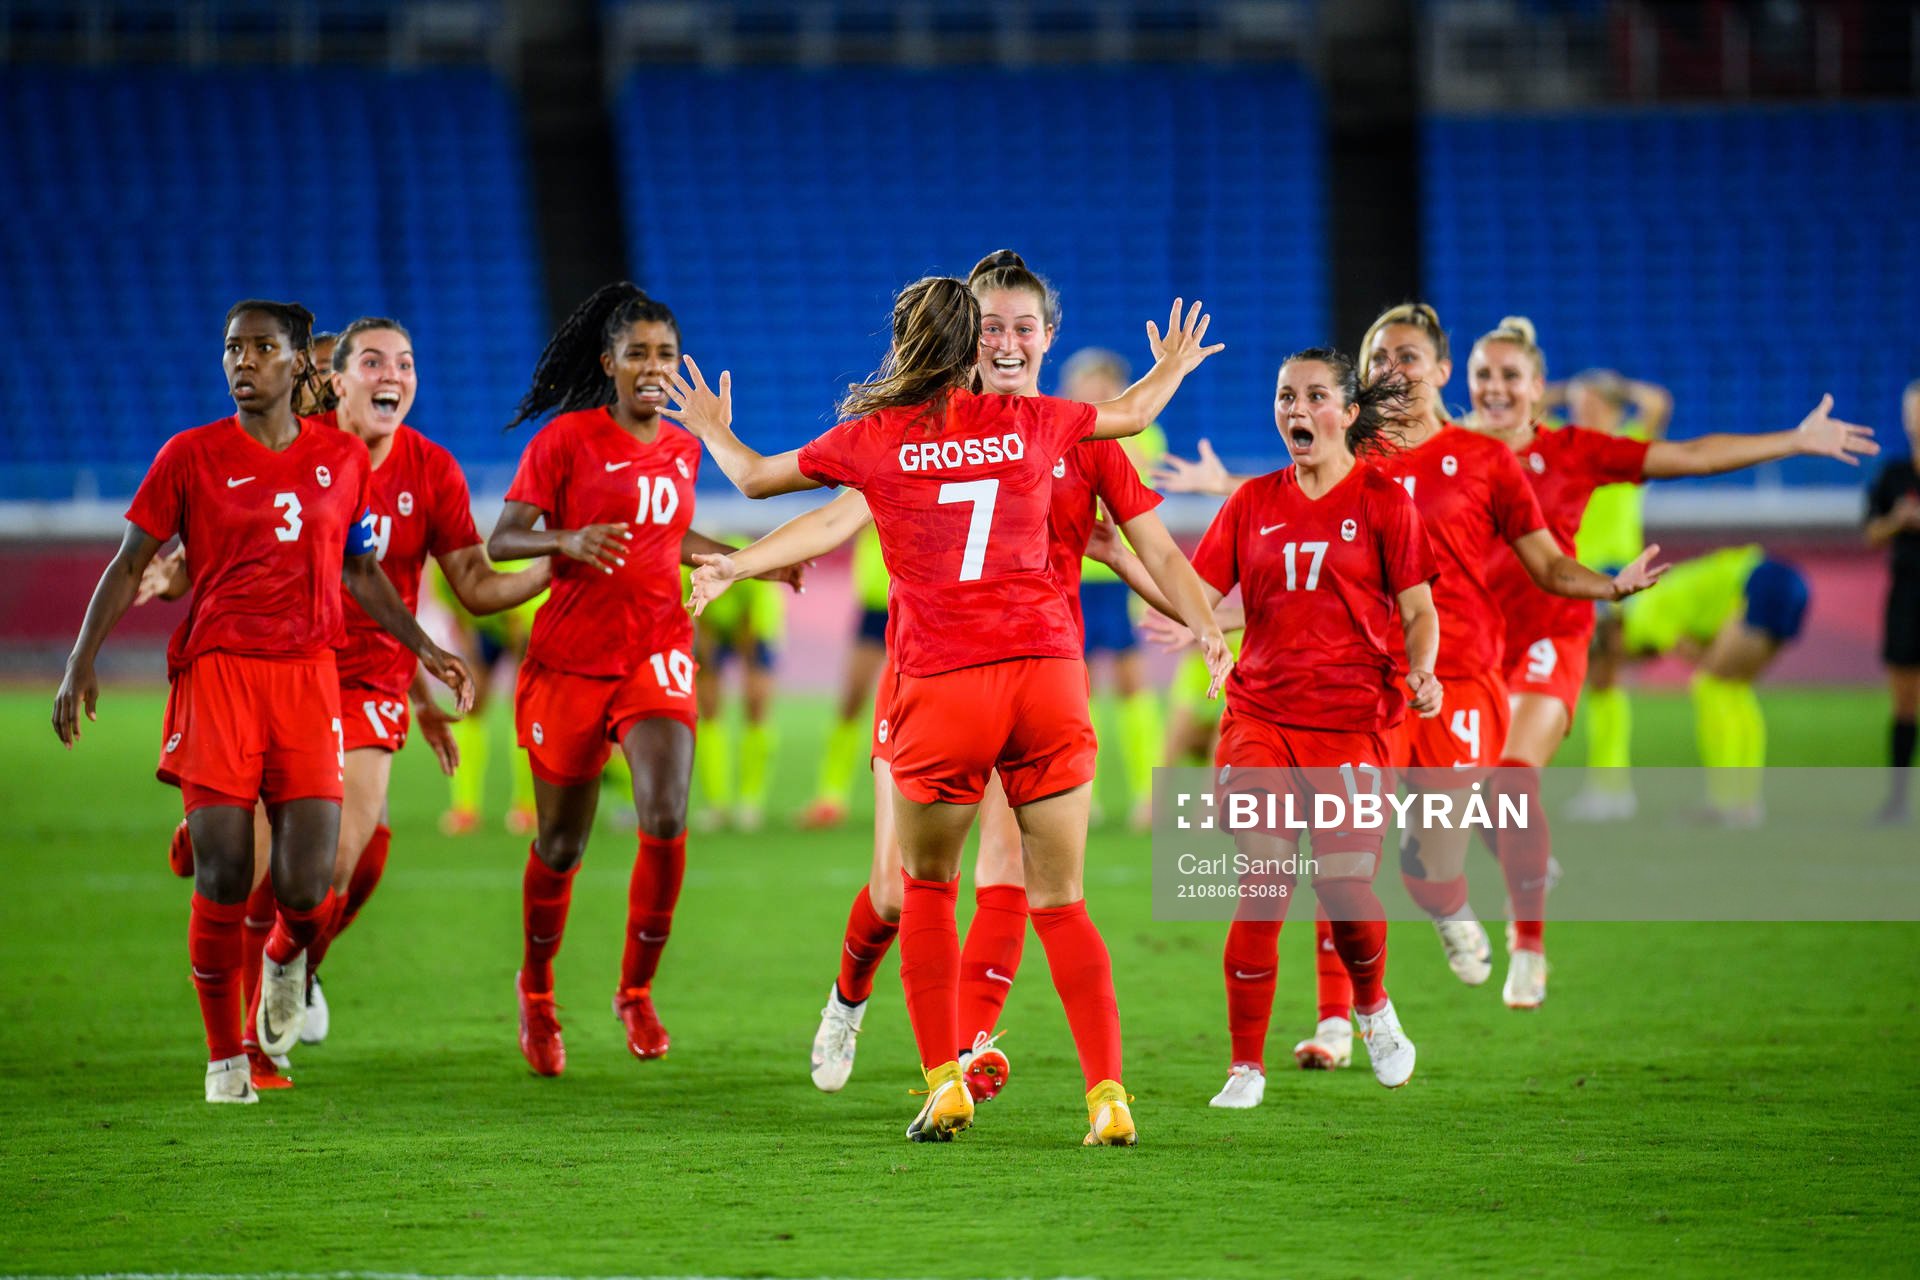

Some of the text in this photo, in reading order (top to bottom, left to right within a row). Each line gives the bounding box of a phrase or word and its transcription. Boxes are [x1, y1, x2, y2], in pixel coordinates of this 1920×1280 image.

[898, 433, 1024, 472] GROSSO
[273, 492, 303, 542] 3
[635, 476, 679, 525] 10
[937, 479, 1000, 582] 7
[1282, 541, 1329, 591] 17
[650, 649, 694, 695] 10
[1527, 637, 1558, 676] 9
[1451, 709, 1480, 759] 4
